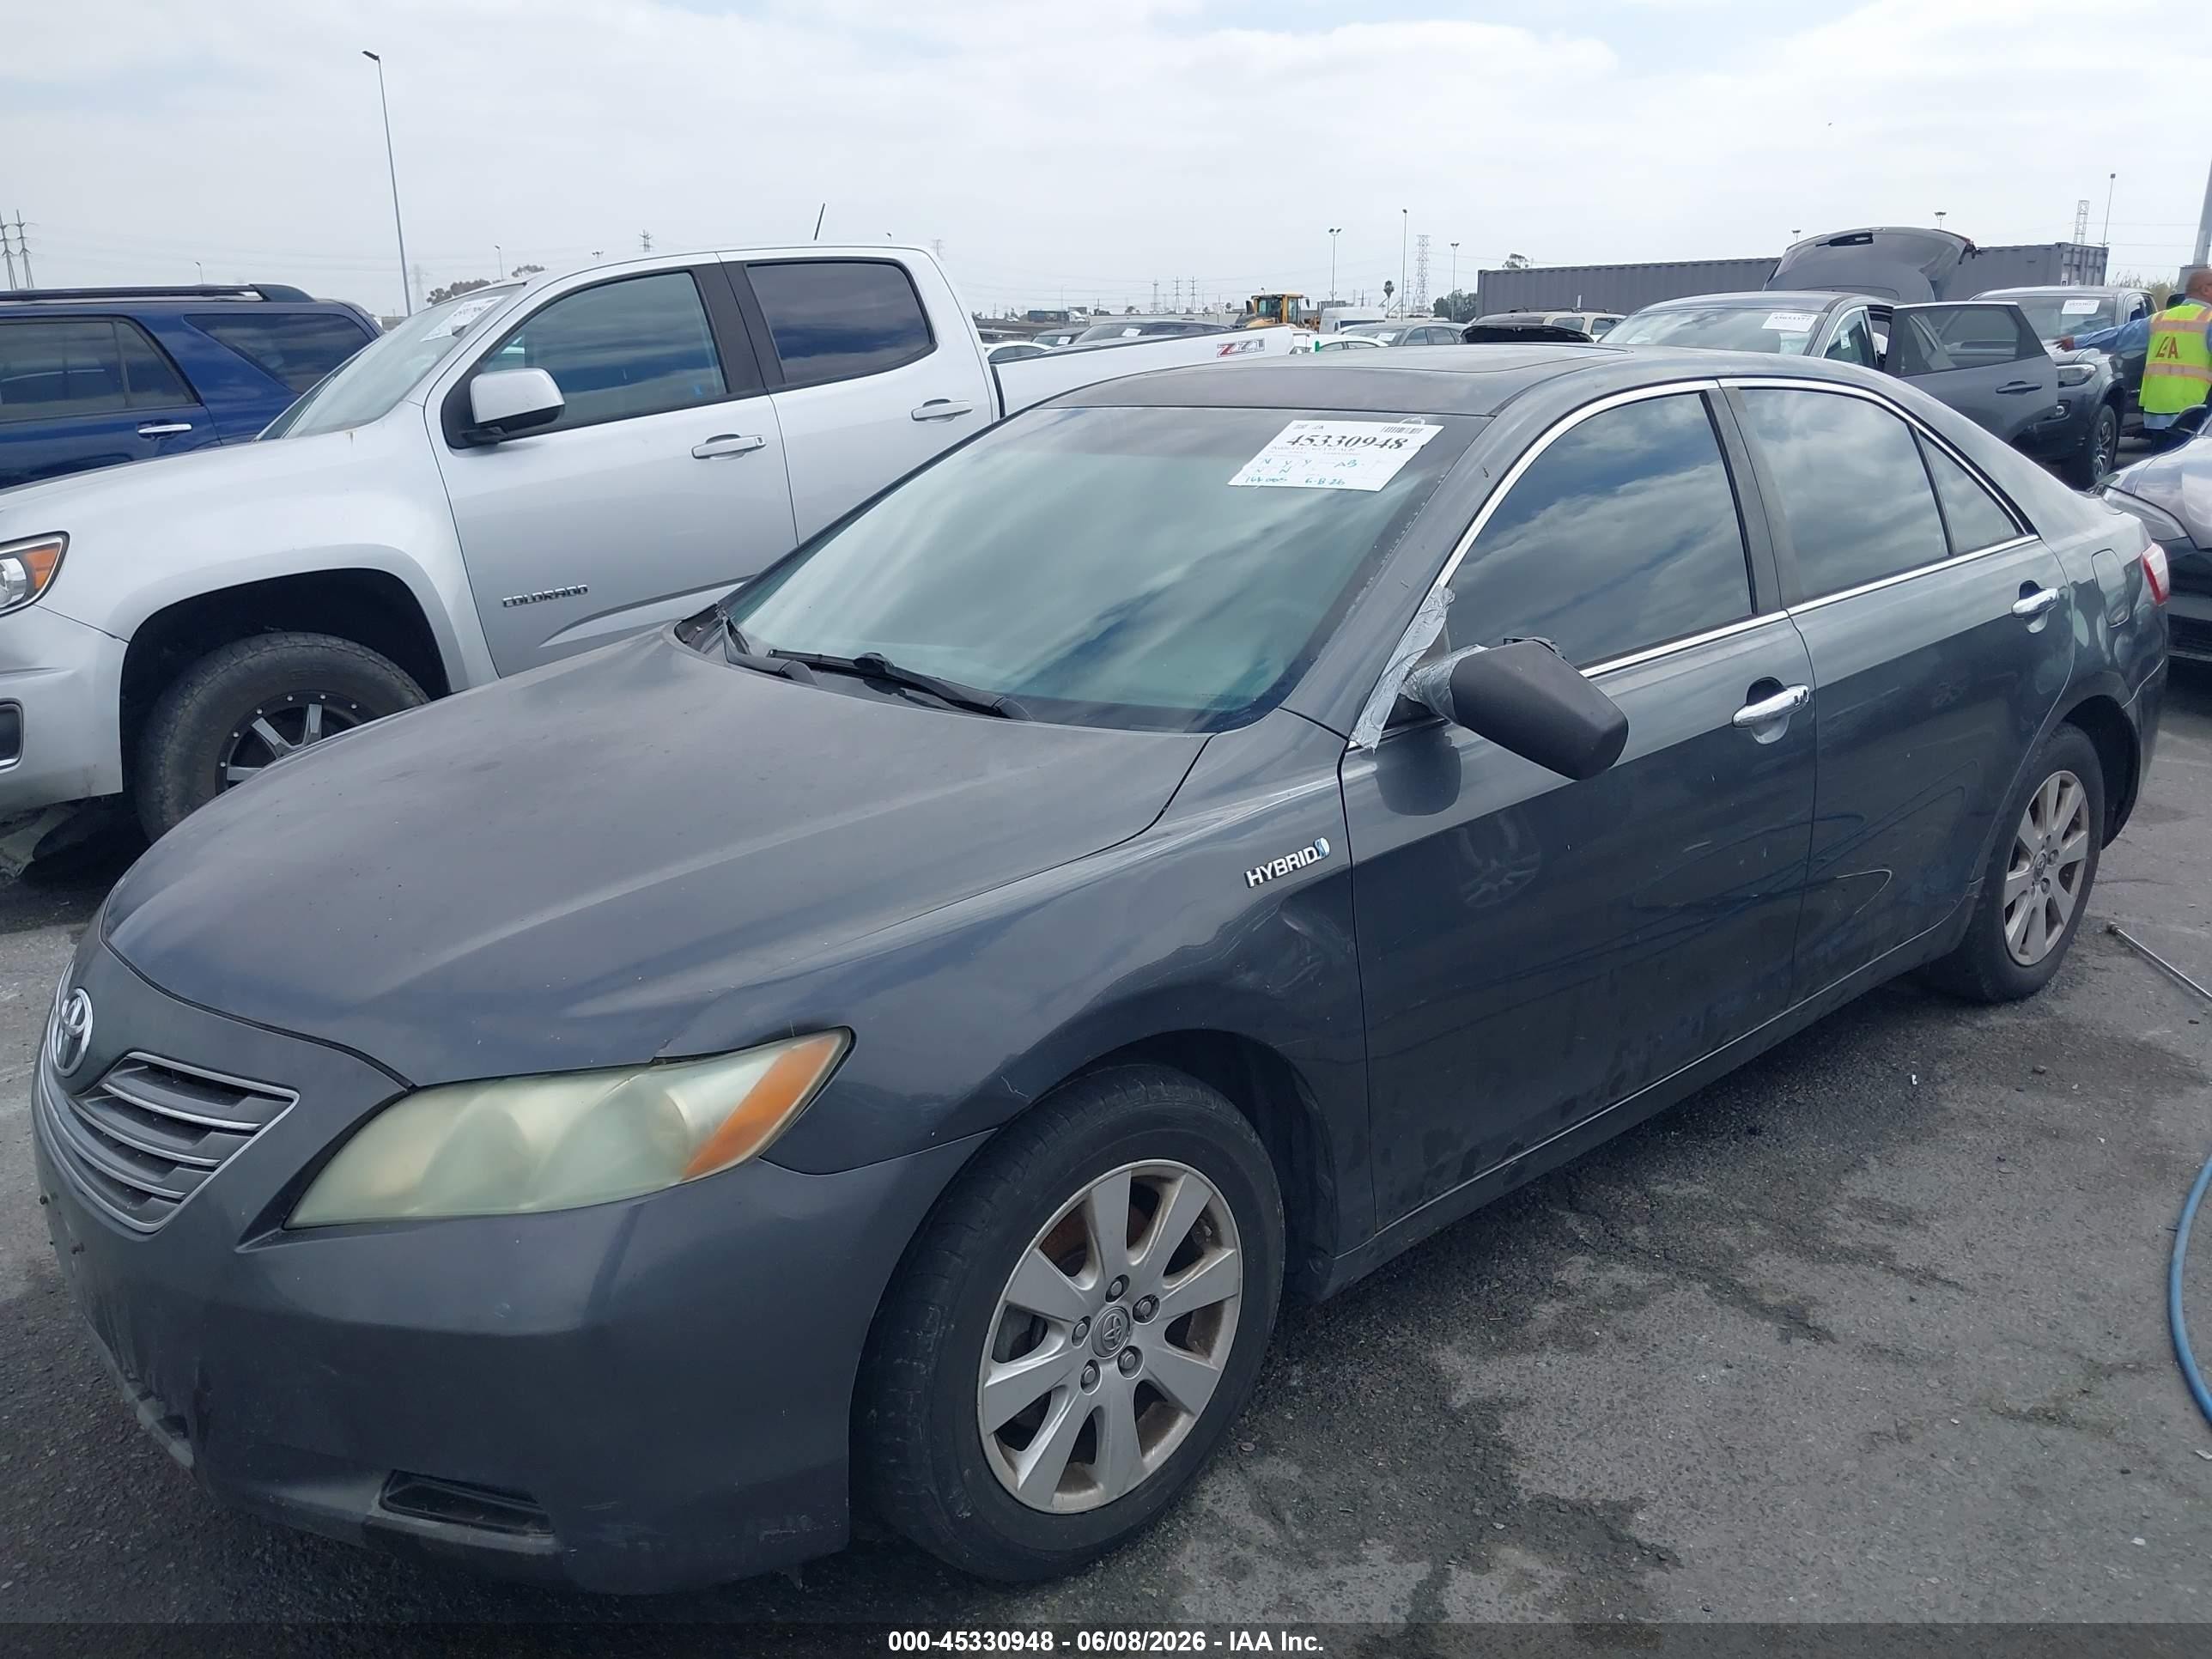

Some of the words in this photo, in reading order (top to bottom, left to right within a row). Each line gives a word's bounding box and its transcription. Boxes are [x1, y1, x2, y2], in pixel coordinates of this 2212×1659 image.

[1217, 338, 1265, 358] Z71
[1285, 434, 1409, 450] 45330948
[502, 584, 588, 608] COLORADO
[1244, 846, 1321, 888] HYBRID
